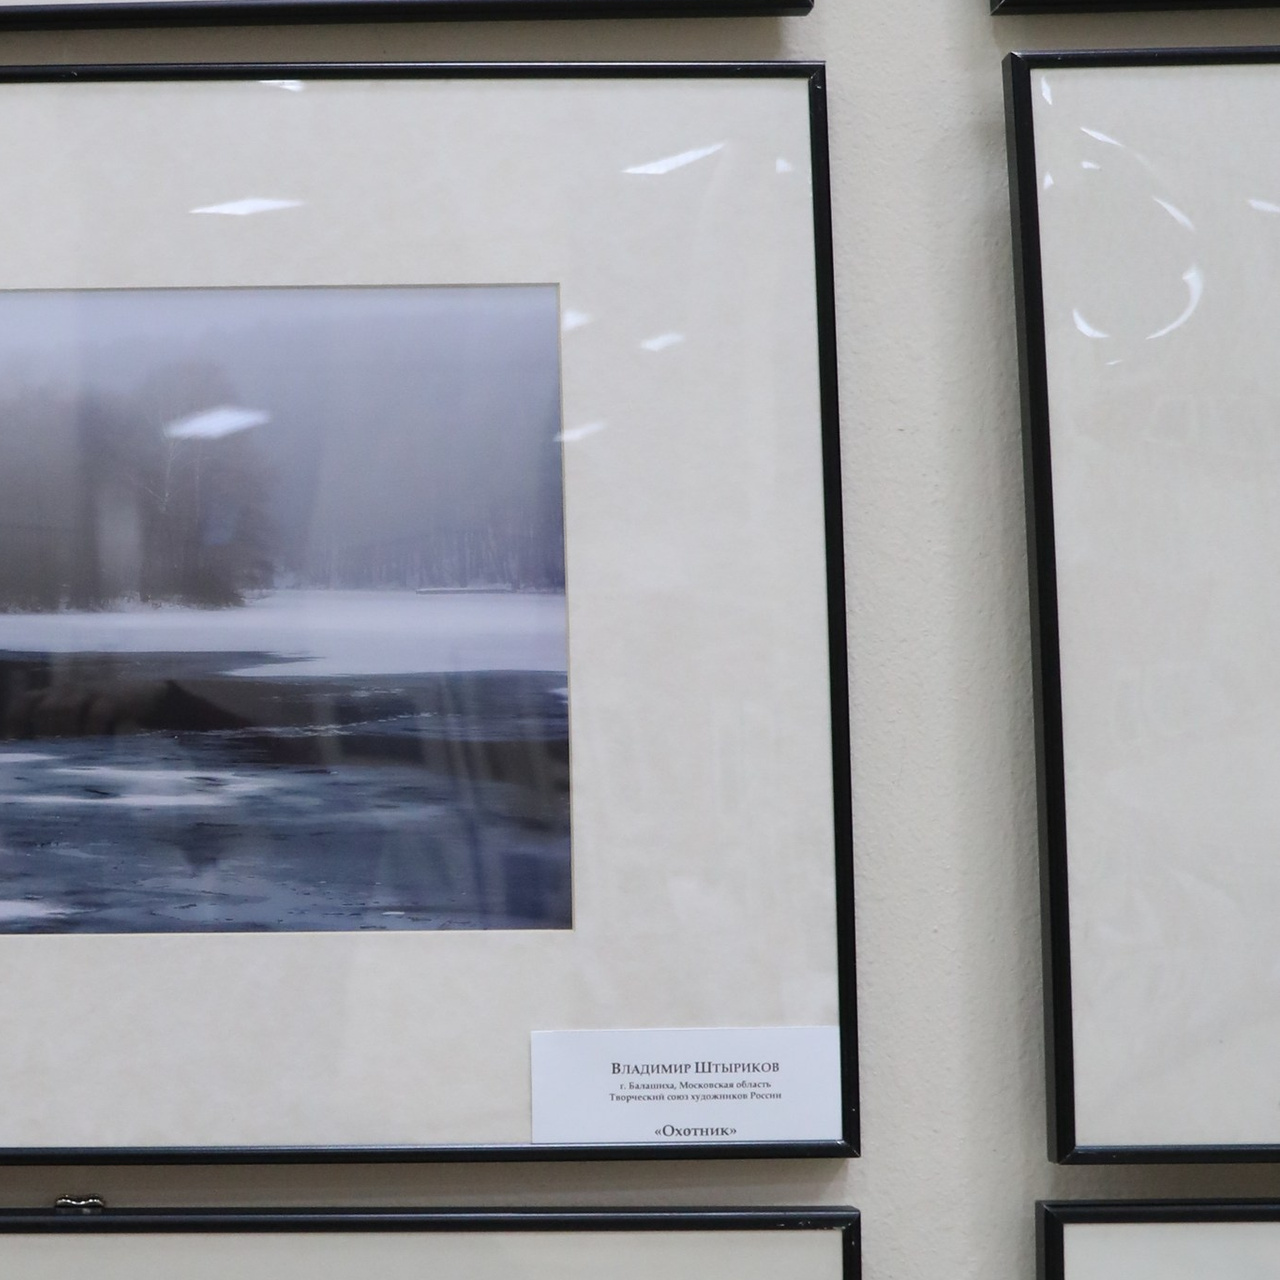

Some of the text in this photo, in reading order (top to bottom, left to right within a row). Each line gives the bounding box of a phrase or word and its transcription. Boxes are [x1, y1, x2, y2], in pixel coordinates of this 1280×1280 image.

[629, 1082, 677, 1090] Балашиха,
[679, 1081, 734, 1089] Московская
[736, 1080, 772, 1089] область
[610, 1093, 665, 1102] Творческий
[691, 1093, 748, 1102] художников
[655, 1125, 737, 1137] «Охотник»
